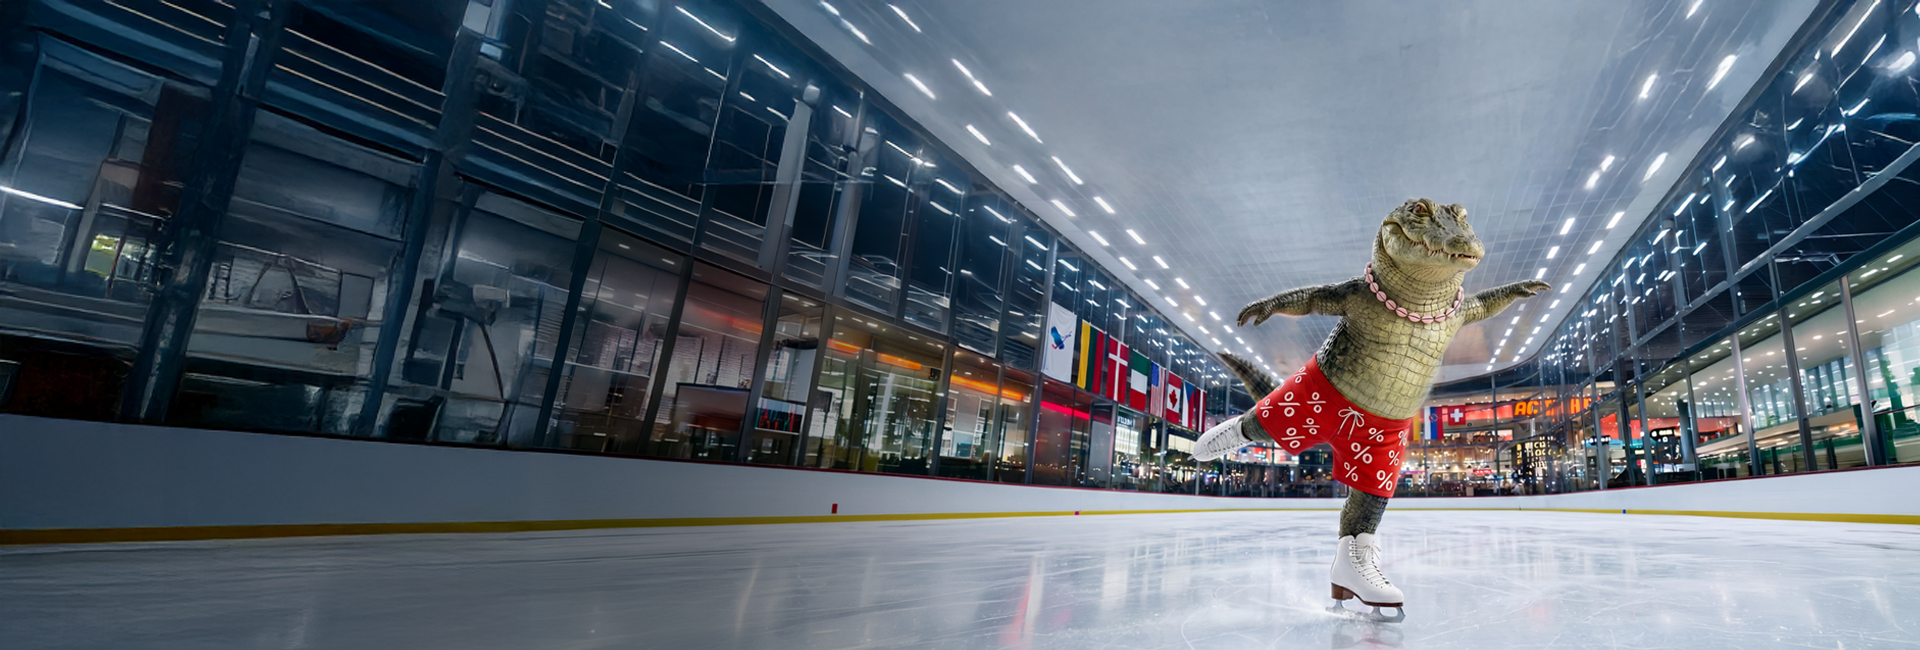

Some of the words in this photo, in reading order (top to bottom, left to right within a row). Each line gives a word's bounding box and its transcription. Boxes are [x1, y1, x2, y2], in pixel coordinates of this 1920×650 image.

[1260, 399, 1273, 418] %
[1278, 391, 1300, 417] %
[1306, 391, 1326, 413] %
[1302, 417, 1320, 435] %
[1368, 427, 1384, 442] %
[1281, 427, 1305, 449] %
[1351, 442, 1372, 464] %
[1388, 450, 1400, 466] %
[1344, 462, 1359, 482] %
[1376, 470, 1393, 491] %
